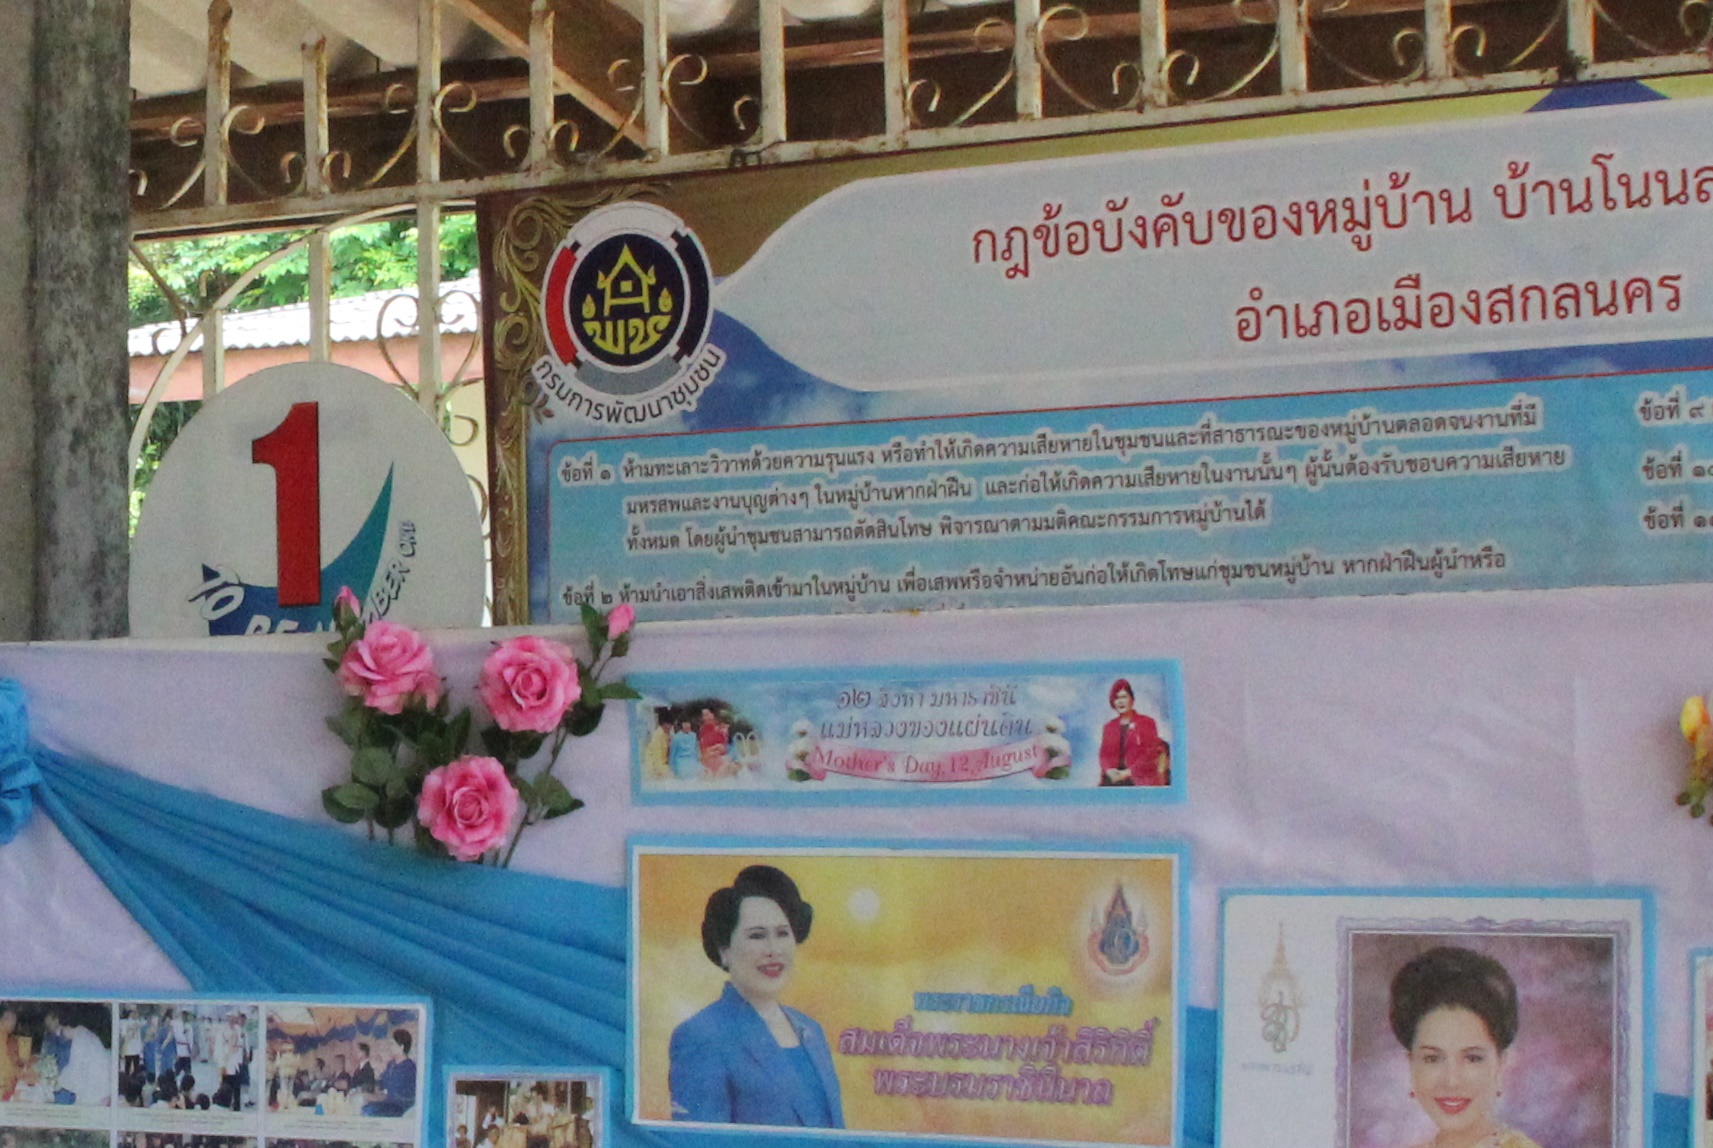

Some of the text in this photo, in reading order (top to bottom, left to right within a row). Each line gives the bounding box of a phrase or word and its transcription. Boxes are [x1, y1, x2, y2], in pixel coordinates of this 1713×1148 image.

[972, 171, 1474, 279] กฎข้อบังคับของหมู่บ้าน
[1235, 273, 1682, 343] อำเภอเมืองสกลนคร
[534, 346, 722, 425] กรมการพัฒนาชุมชน
[1639, 391, 1680, 421] ข้อที่
[561, 457, 593, 482] ข้อที่
[600, 468, 611, 480] ๑
[622, 449, 875, 479] ห้ามทะเลาะวิวาทด้วยความรุนแรง
[1642, 450, 1682, 480] ข้อที่
[251, 401, 319, 607] 1
[1643, 500, 1684, 530] ข้อที่
[626, 525, 680, 551] ทั้งหมด
